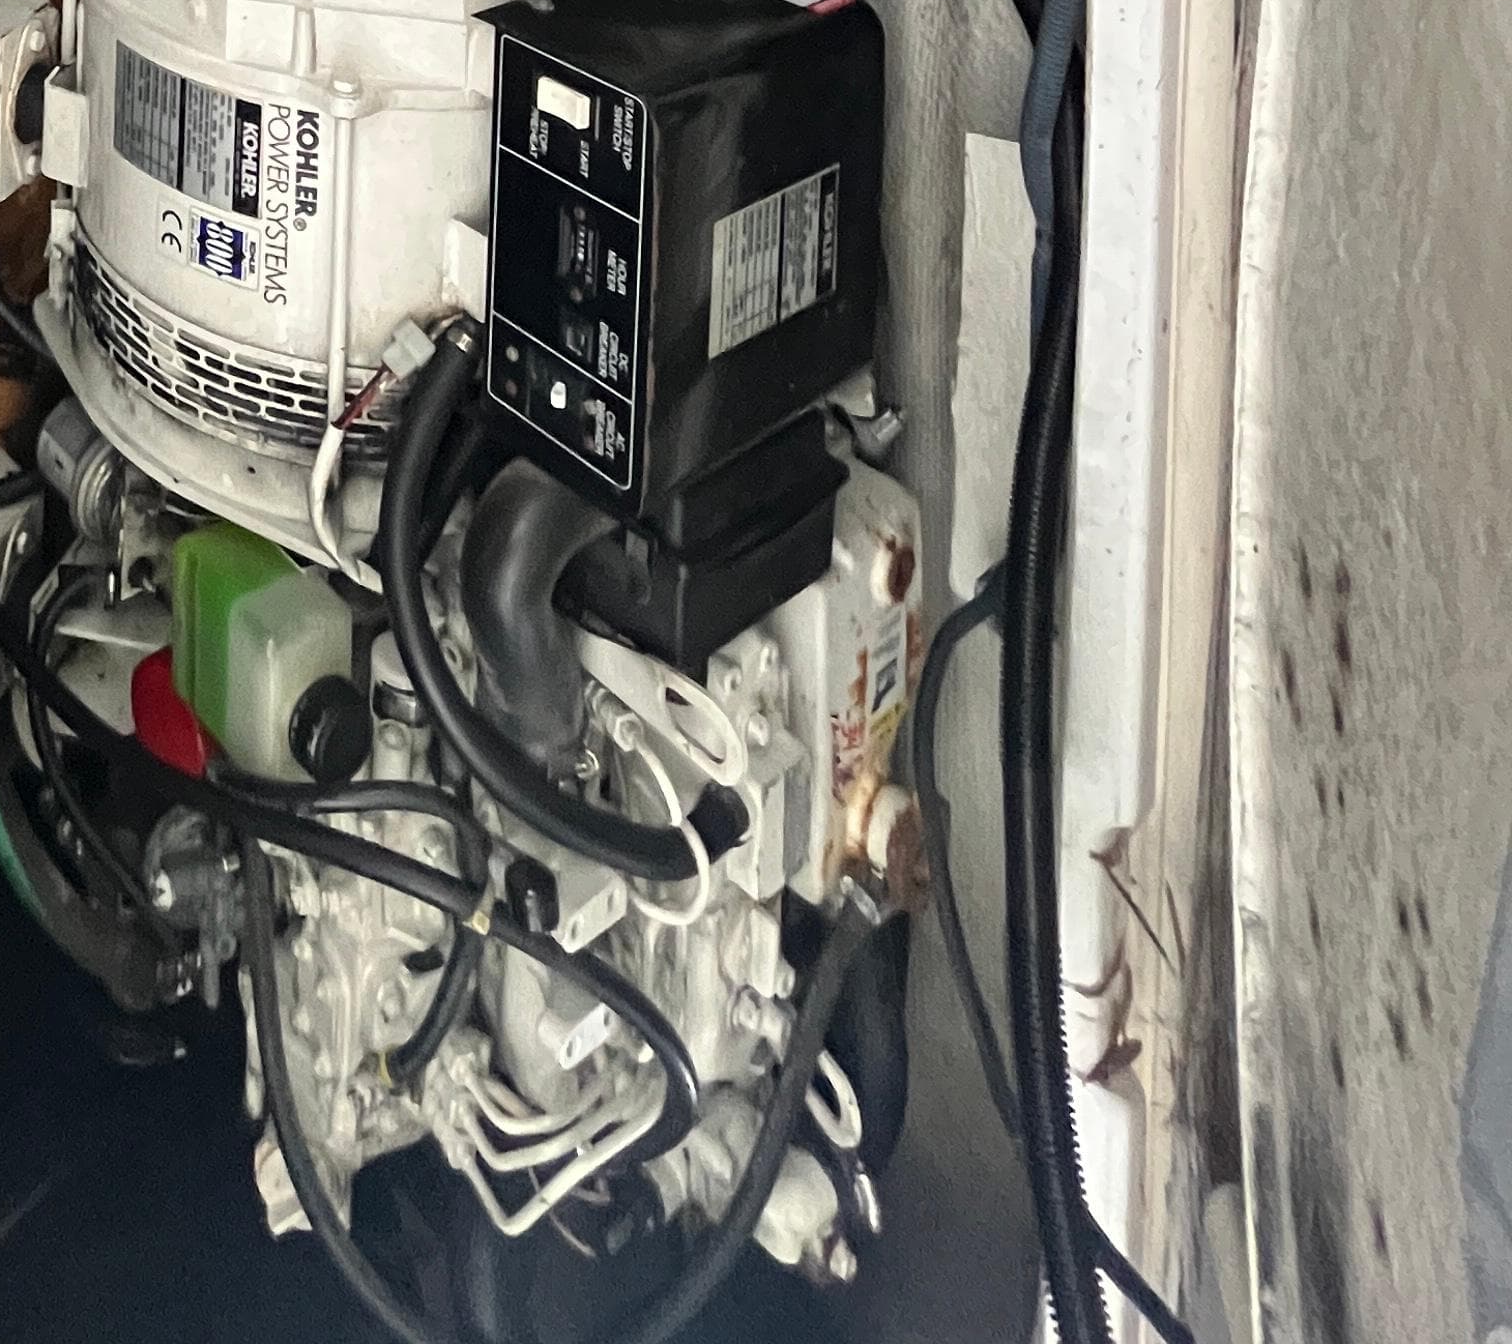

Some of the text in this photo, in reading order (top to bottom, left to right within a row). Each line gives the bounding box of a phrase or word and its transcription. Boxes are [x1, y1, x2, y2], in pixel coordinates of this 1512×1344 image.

[205, 222, 235, 282] 800
[263, 103, 291, 306] POWER SYSTEMS
